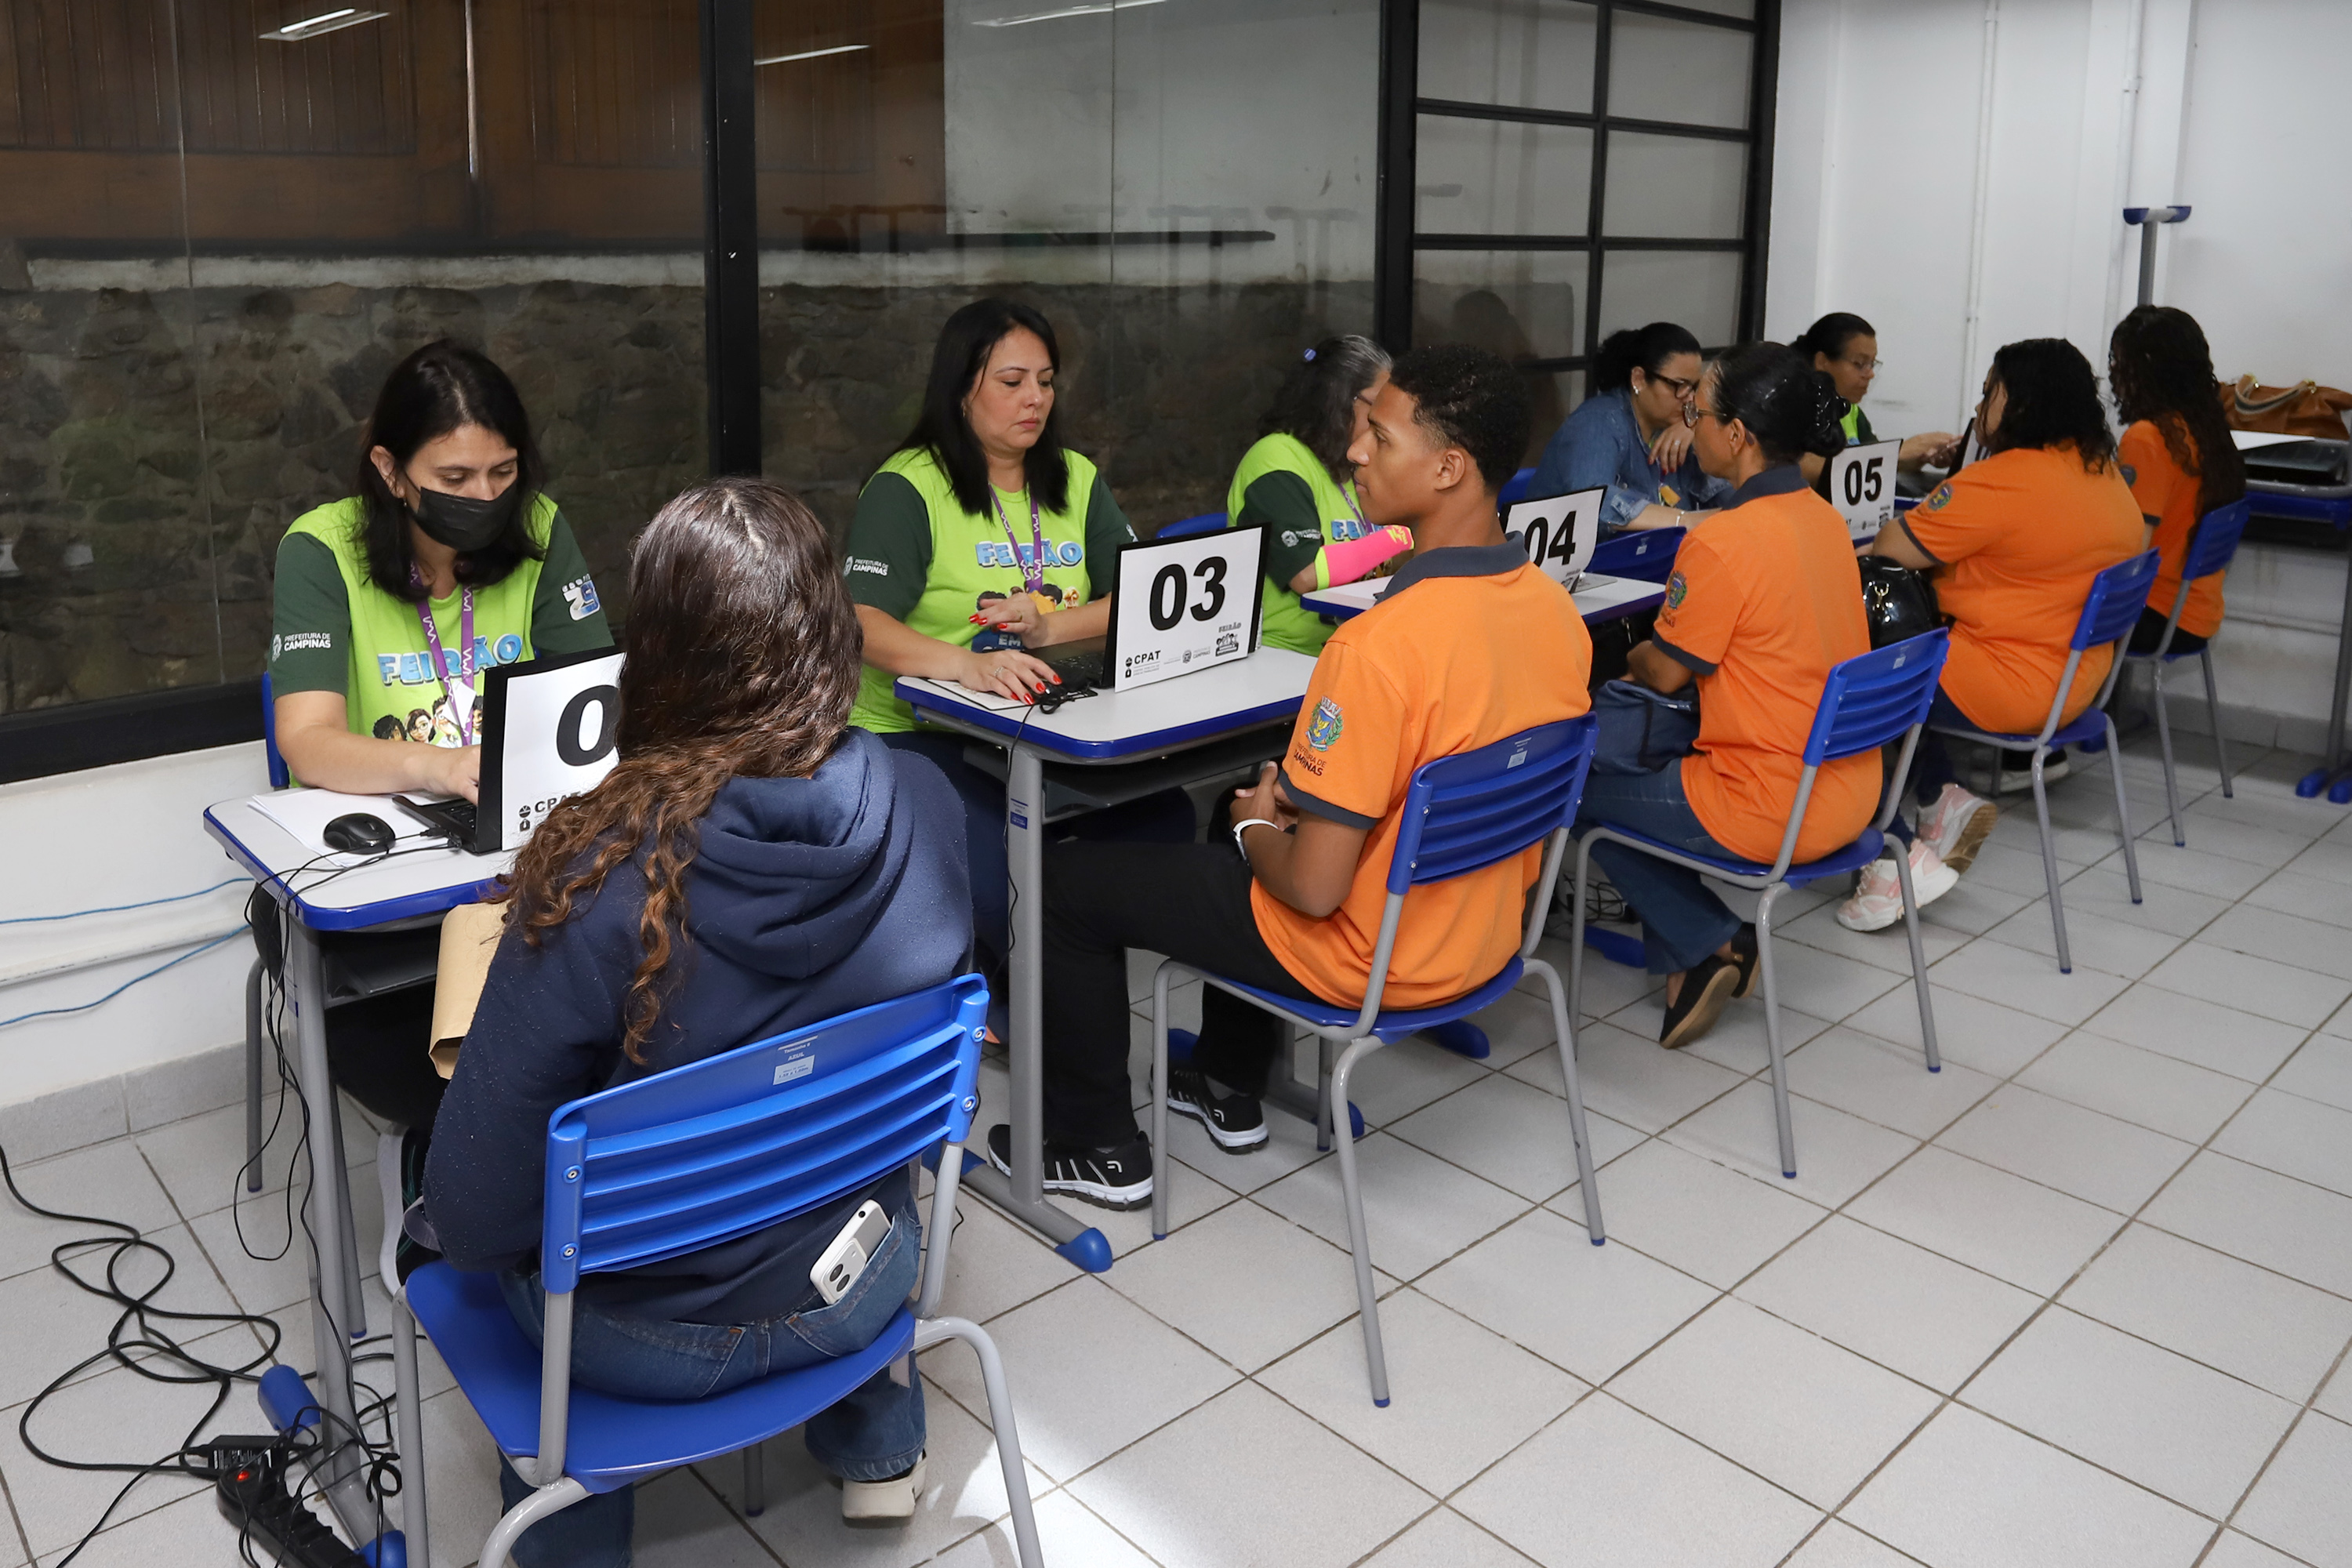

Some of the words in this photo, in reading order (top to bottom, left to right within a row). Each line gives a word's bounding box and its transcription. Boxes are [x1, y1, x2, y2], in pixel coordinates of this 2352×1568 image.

[1845, 457, 1883, 506] 05
[1525, 510, 1577, 568] 04
[975, 538, 1083, 568] FERÃO
[852, 564, 888, 576] CAMPINAS
[855, 559, 882, 568] PREFEITURA
[1149, 556, 1227, 631] 03
[285, 633, 321, 642] PREFEITURA
[284, 639, 331, 652] CAMPINAS
[1134, 650, 1161, 664] CPAT
[556, 684, 622, 767] 0
[1317, 759, 1327, 768] DE
